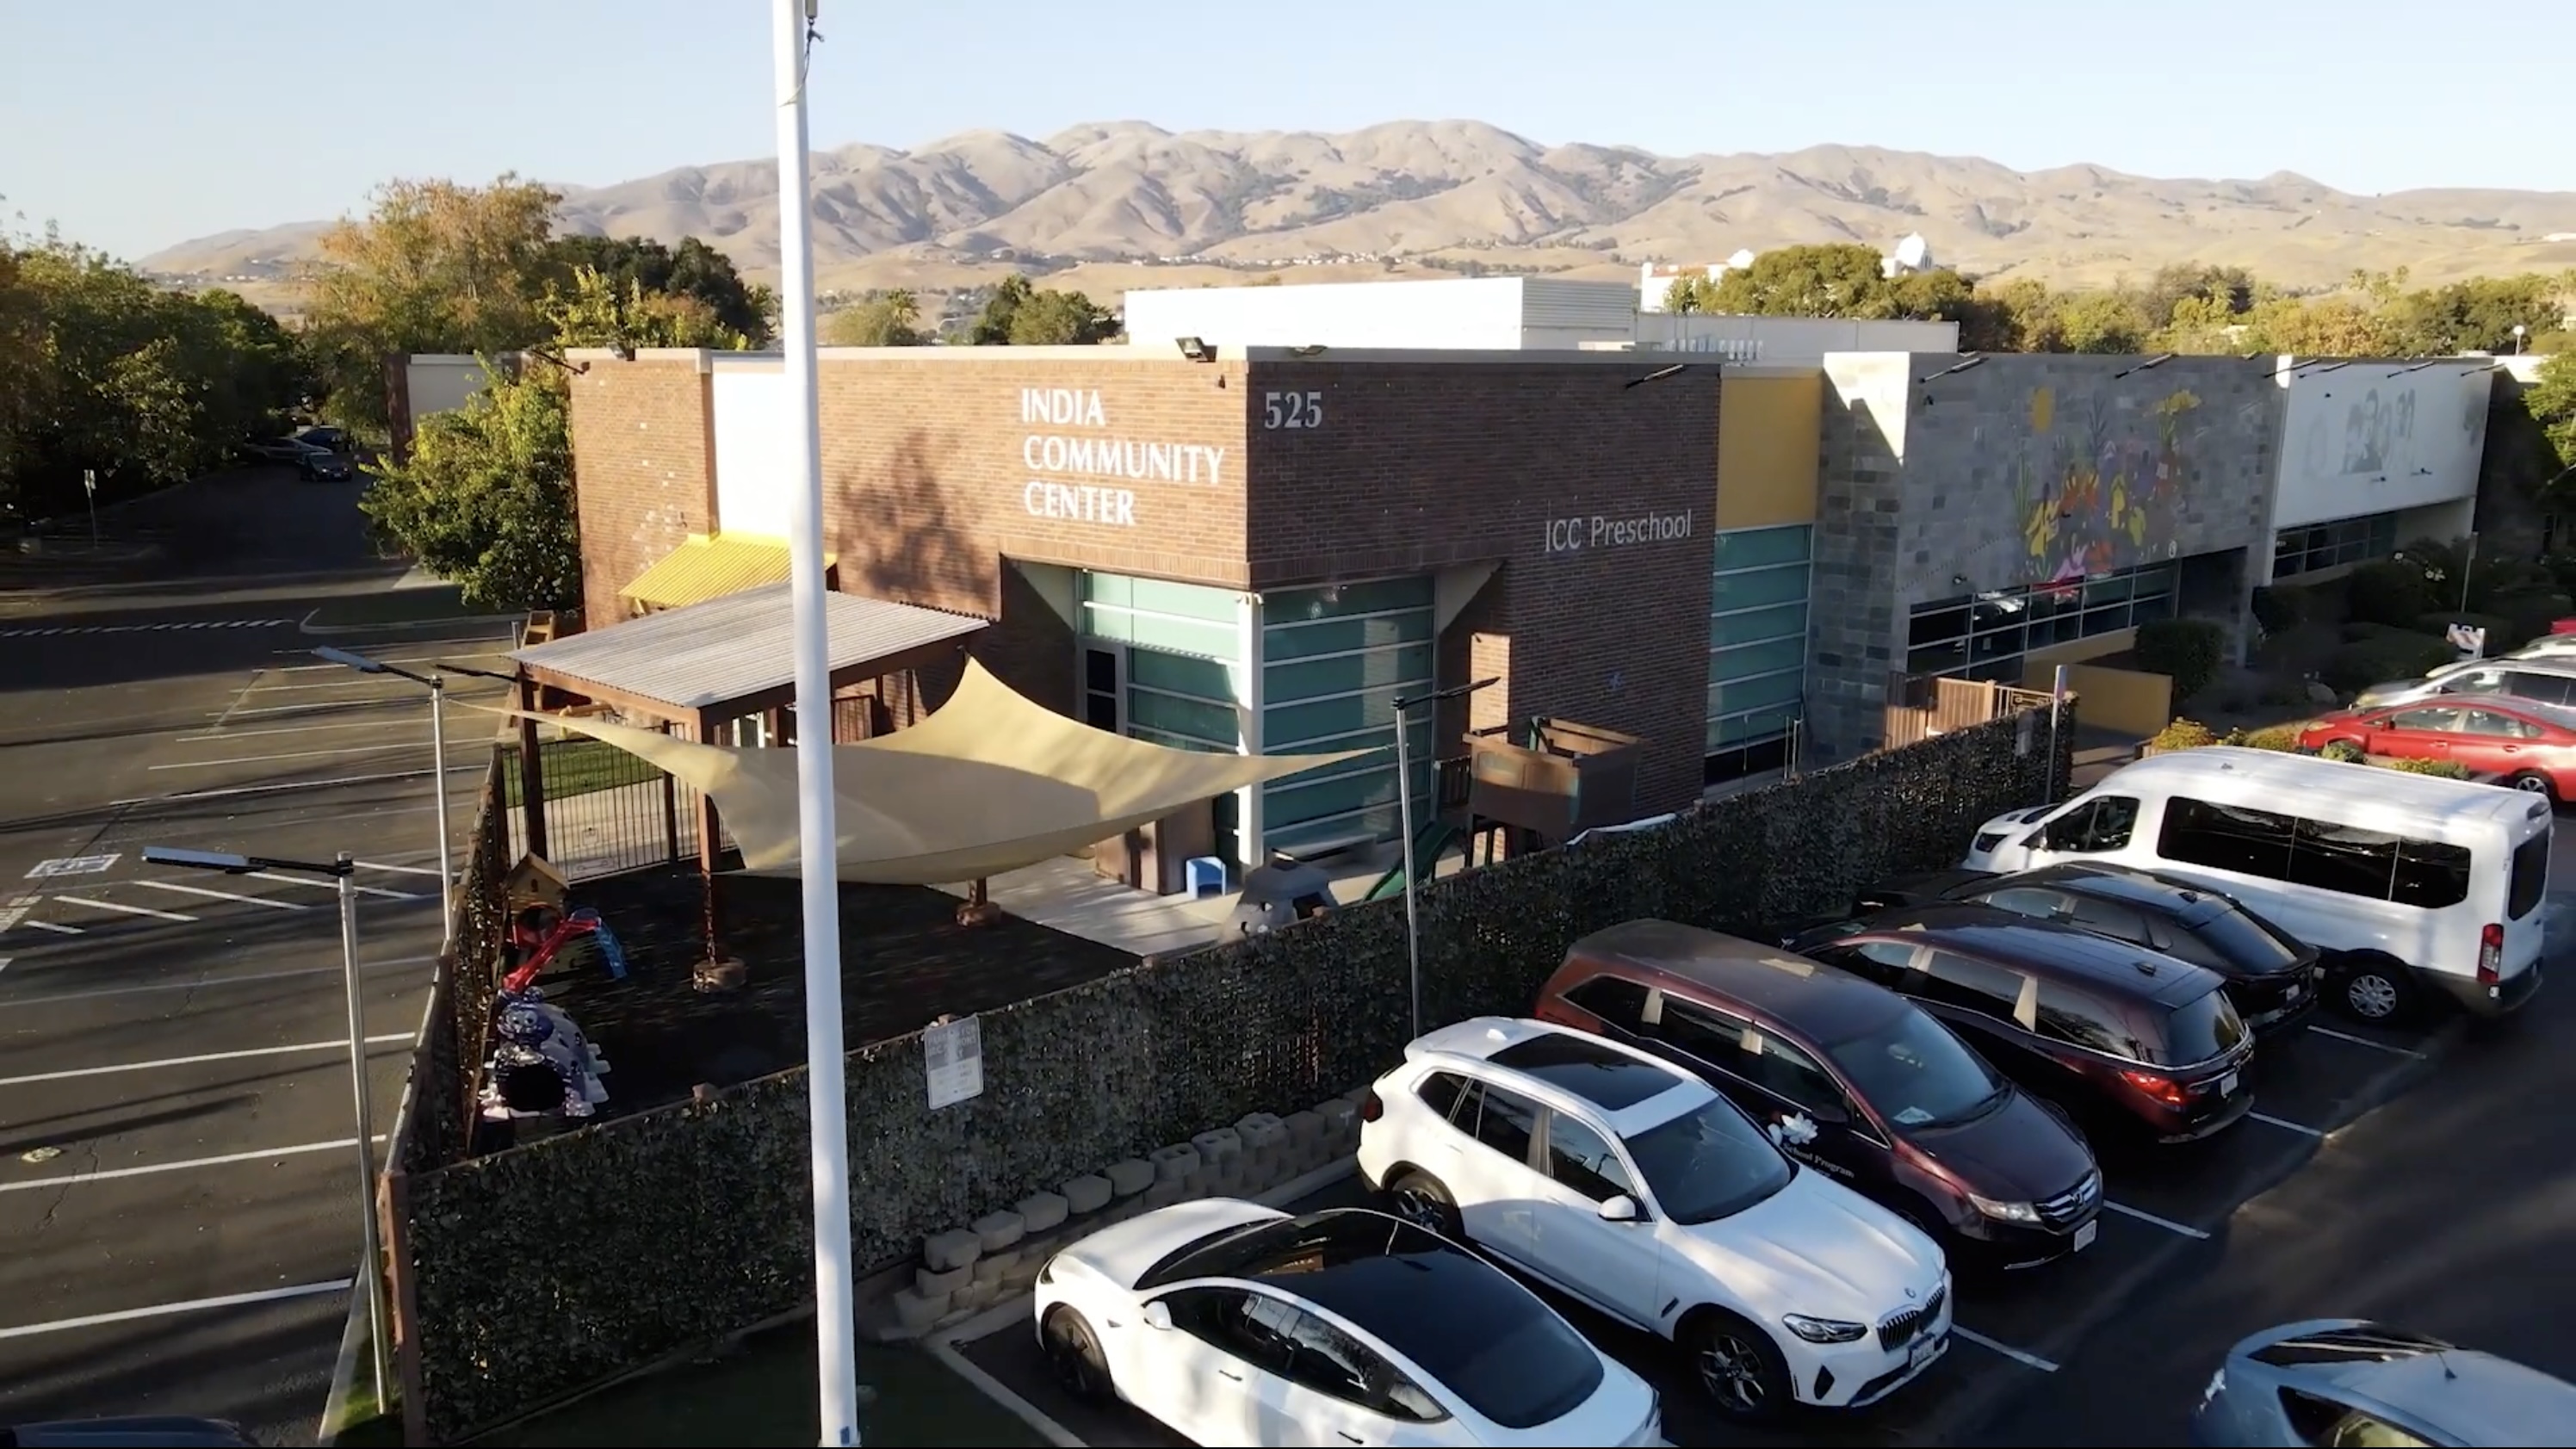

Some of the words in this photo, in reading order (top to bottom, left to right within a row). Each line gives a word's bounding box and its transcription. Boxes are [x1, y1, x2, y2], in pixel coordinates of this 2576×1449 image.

[1022, 388, 1105, 426] INDIA
[1264, 391, 1322, 430] 525
[1024, 436, 1225, 484] COMMUNITY
[1024, 481, 1136, 526] CENTER
[1545, 517, 1582, 552] ICC
[1591, 509, 1692, 547] Preschool
[1814, 1155, 1855, 1178] Program
